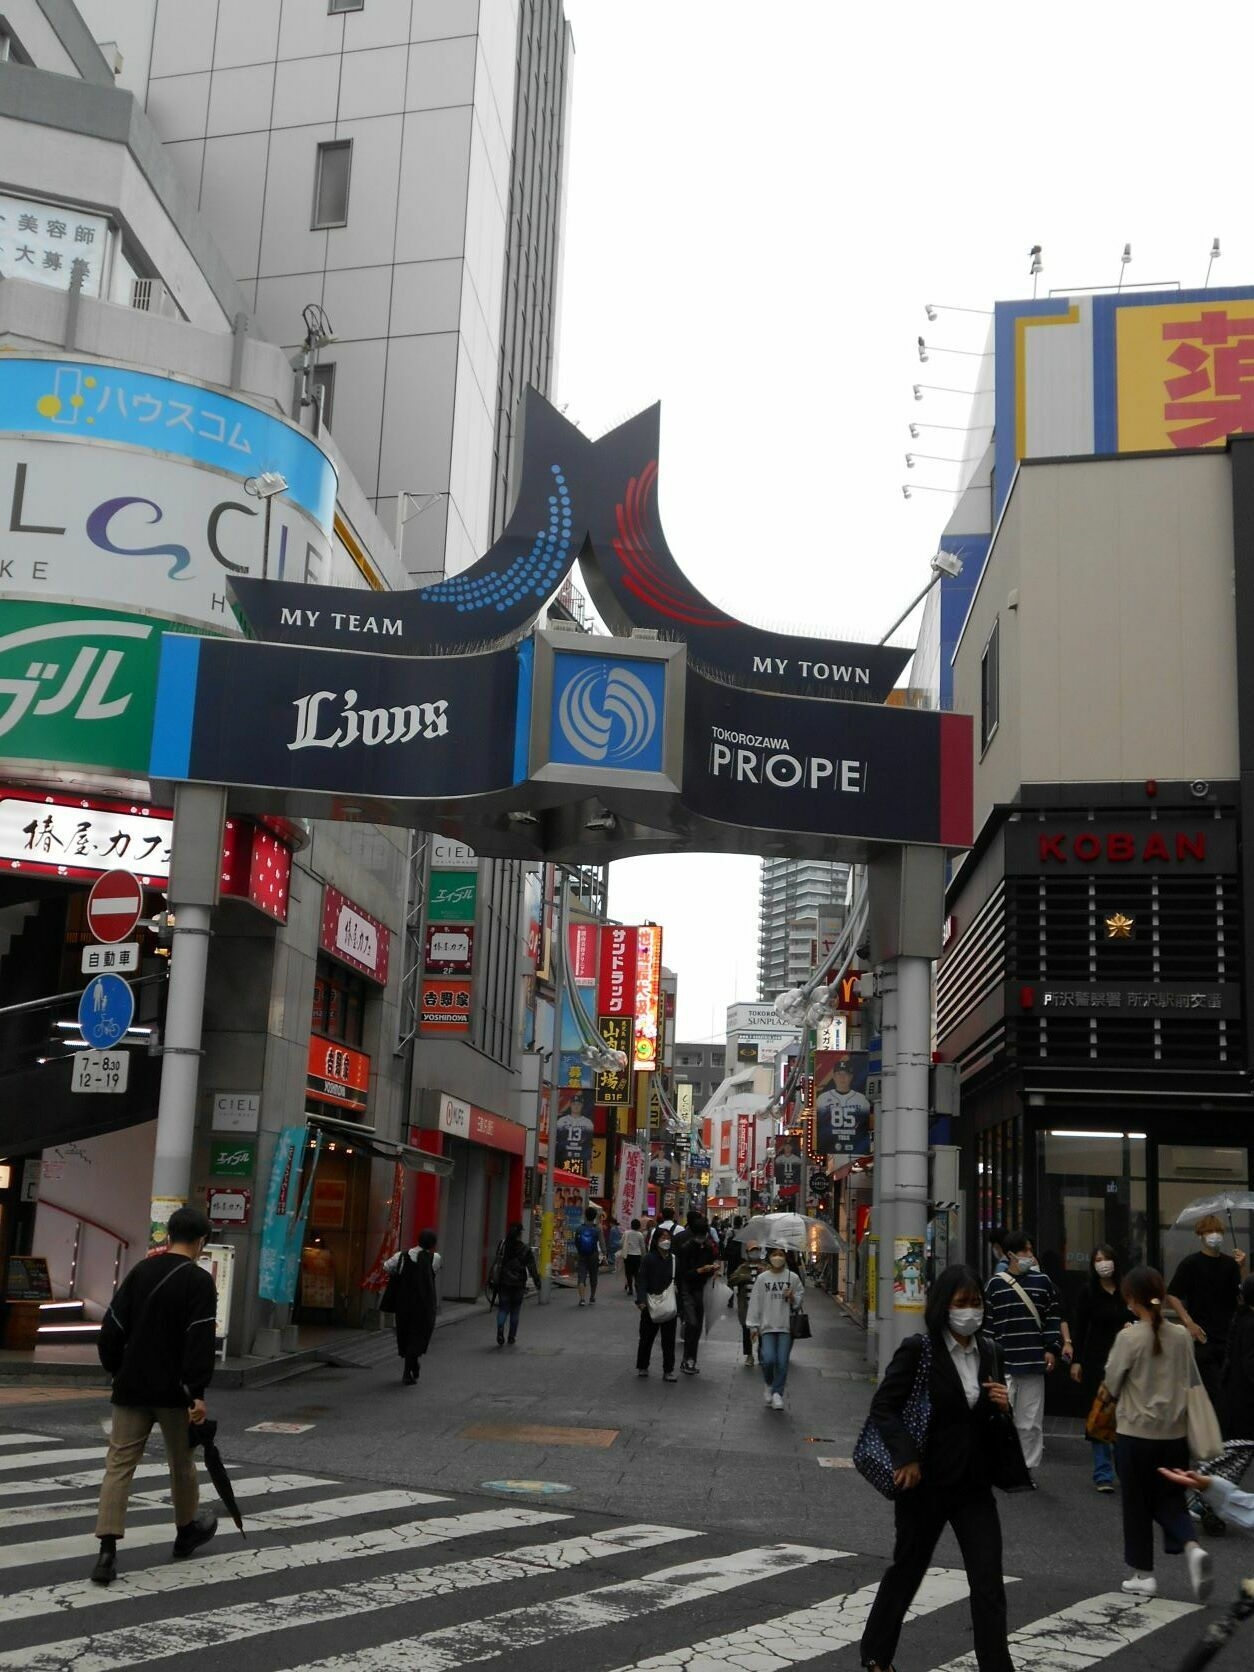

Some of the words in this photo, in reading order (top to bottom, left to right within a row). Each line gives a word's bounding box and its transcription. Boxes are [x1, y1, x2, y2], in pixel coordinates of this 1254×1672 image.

[97, 387, 252, 454] ハウスコム
[280, 607, 321, 628] MY
[331, 612, 404, 636] TEAM
[752, 656, 789, 675] MY
[798, 660, 871, 684] TOWN
[286, 689, 450, 751] Lions
[711, 726, 790, 751] TOKOROZAWA
[711, 743, 863, 793] PROPE
[1038, 832, 1208, 863] KOBAN
[431, 885, 475, 903] エイブル
[89, 952, 131, 967] 自動車
[609, 928, 627, 1012] サンドラッグ
[423, 991, 469, 1007] 吉野家
[423, 1013, 468, 1023] YOSHINOYA
[600, 1021, 620, 1089] 山内場
[218, 1098, 256, 1111] CIEL
[603, 1093, 623, 1101] B1F
[830, 1106, 856, 1128] 85
[566, 1127, 582, 1142] 13
[656, 1166, 667, 1176] 12
